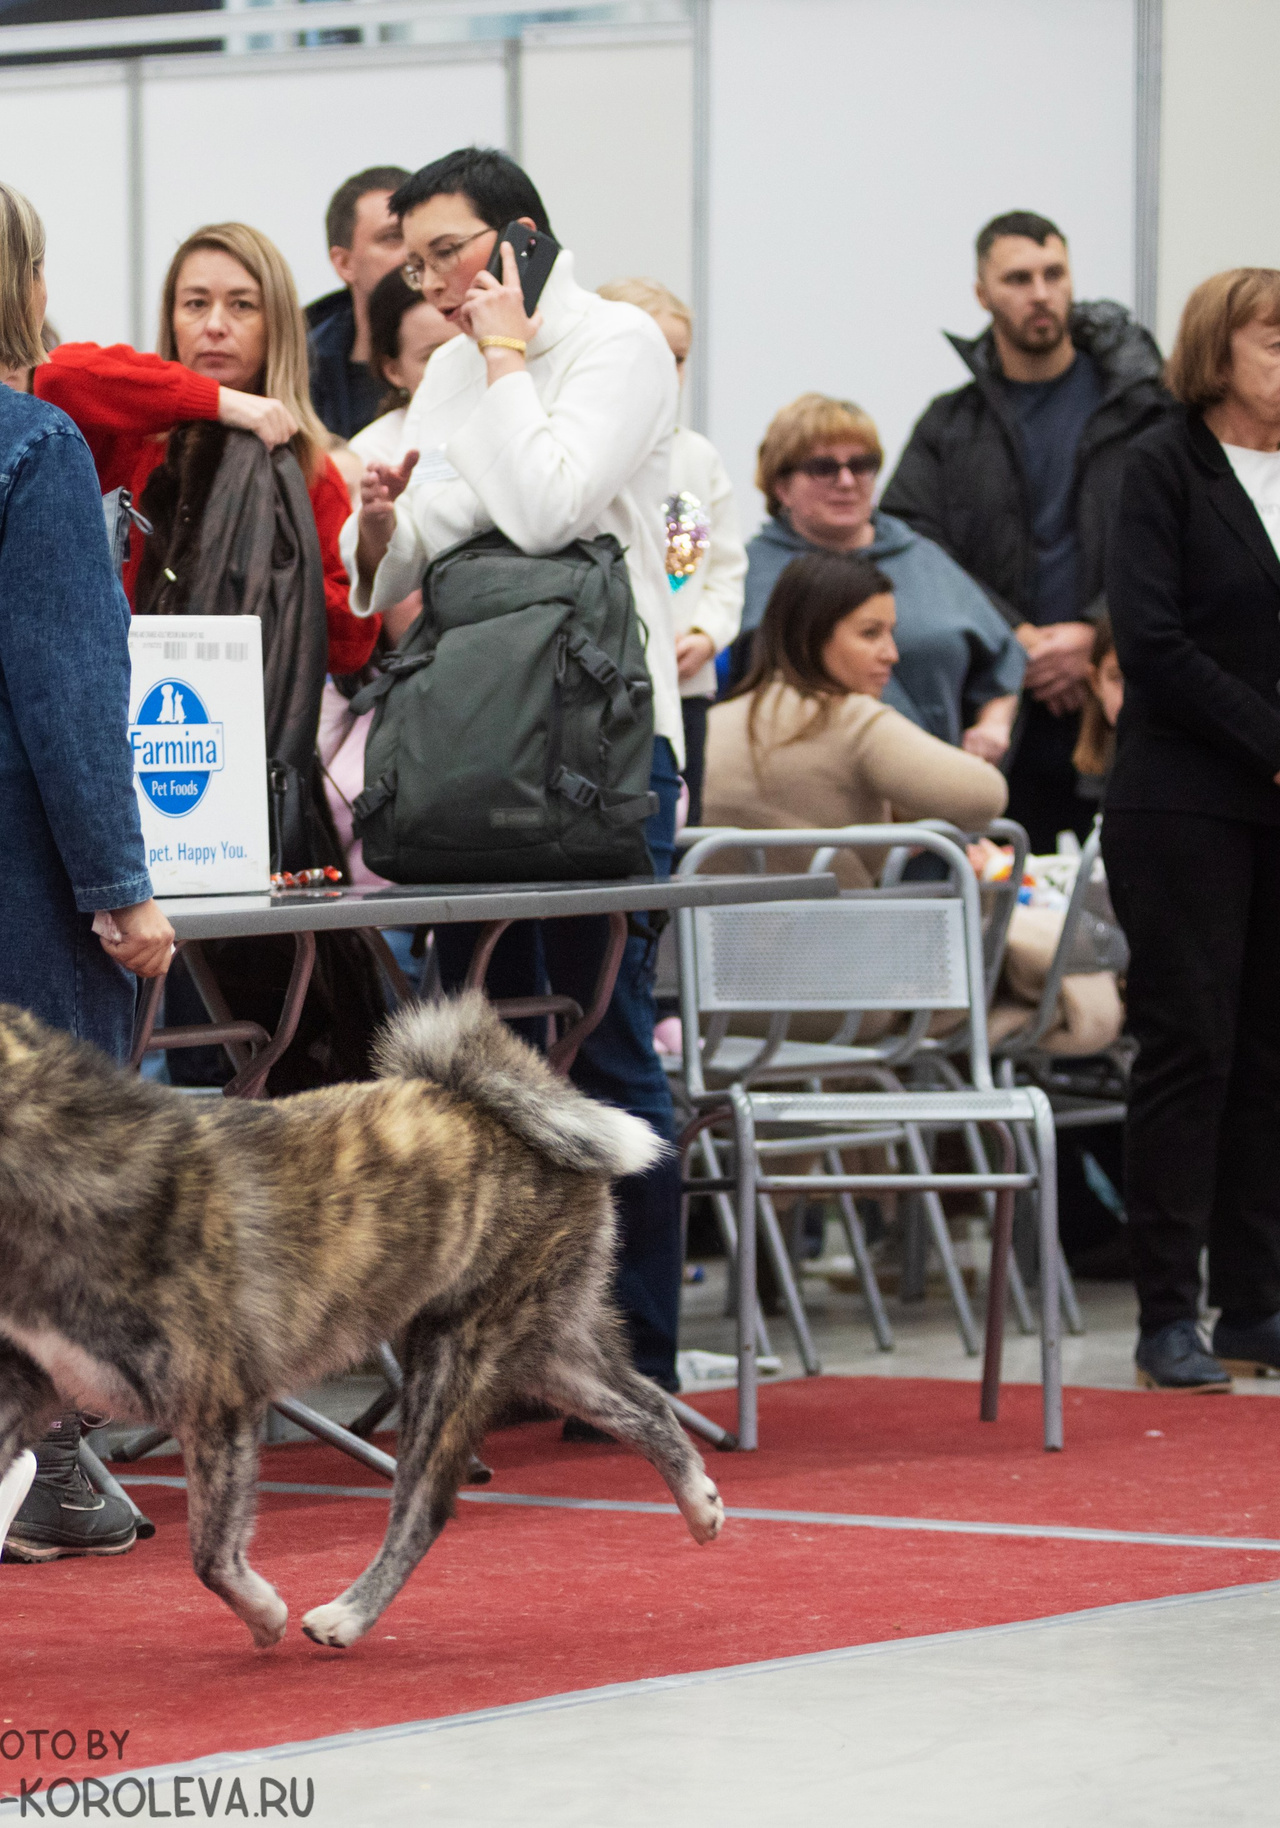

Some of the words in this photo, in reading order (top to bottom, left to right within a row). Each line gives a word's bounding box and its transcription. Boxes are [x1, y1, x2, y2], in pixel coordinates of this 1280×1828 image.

[130, 730, 217, 765] Farmina
[151, 780, 168, 796] Pet
[170, 780, 199, 796] Foods
[149, 844, 173, 867] pet.
[177, 842, 216, 865] Happy
[221, 841, 247, 859] You.
